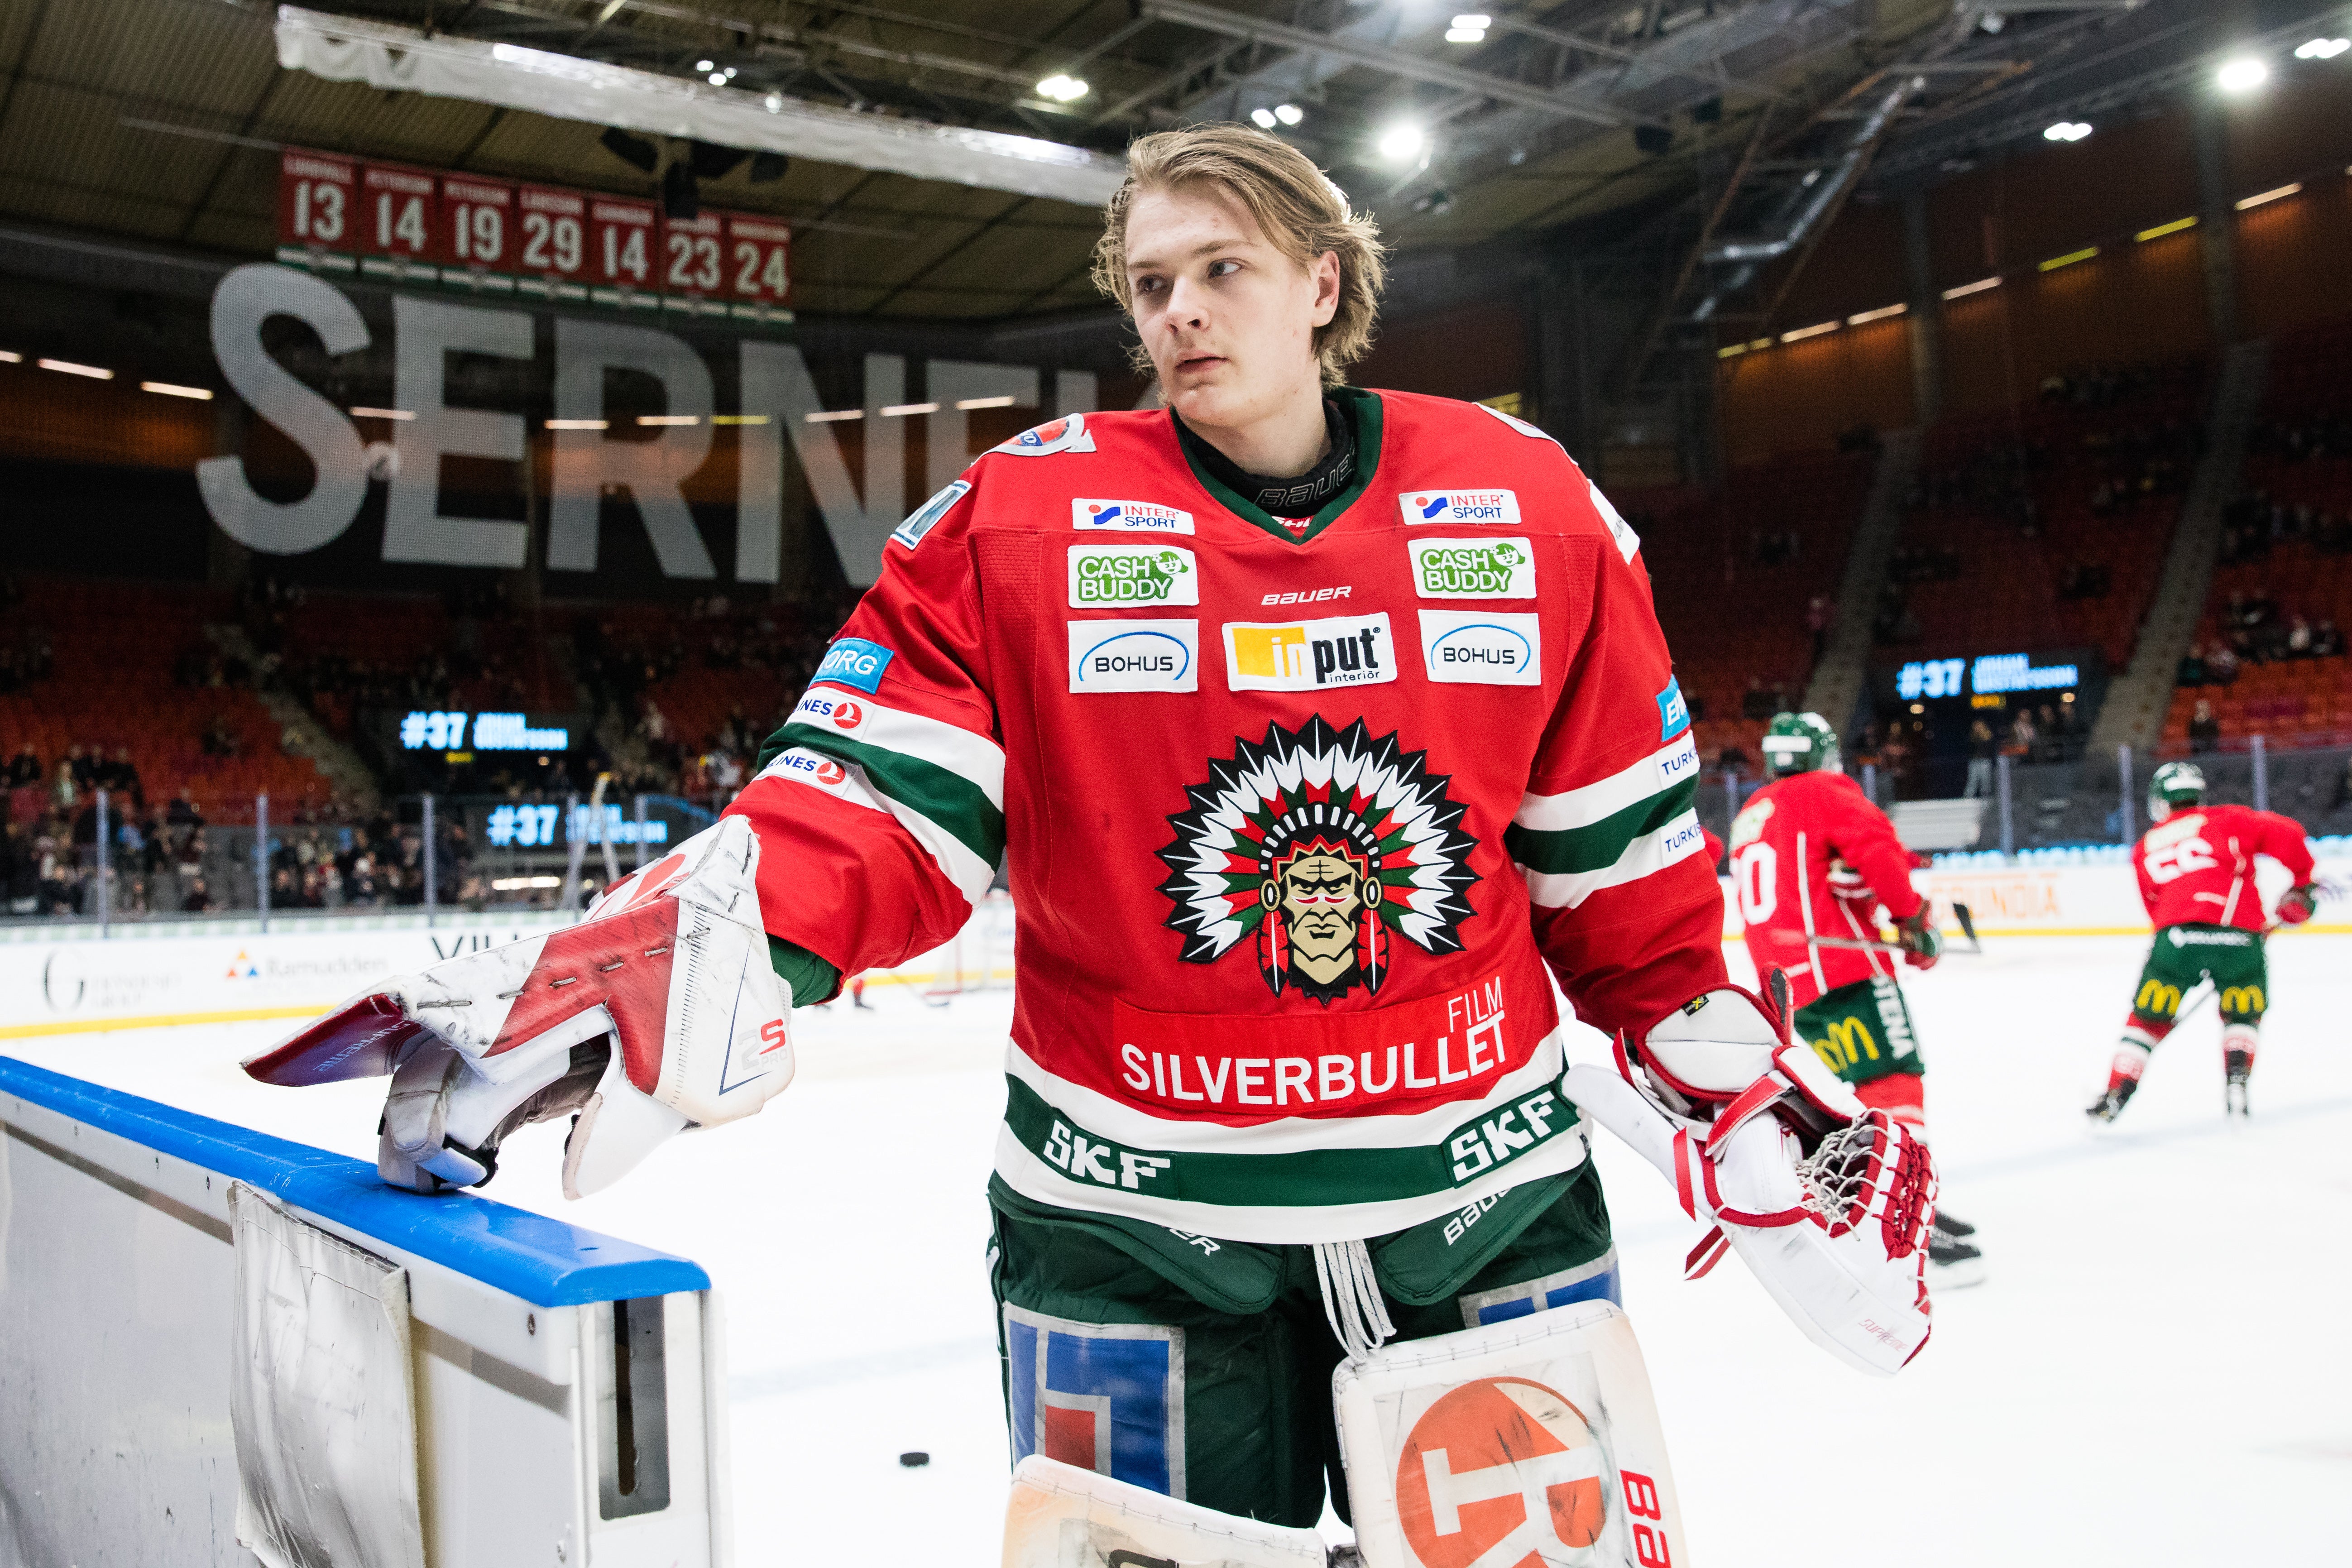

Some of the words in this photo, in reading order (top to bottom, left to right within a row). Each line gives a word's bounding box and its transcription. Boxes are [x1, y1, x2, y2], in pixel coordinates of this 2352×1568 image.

[294, 180, 345, 241] 13
[375, 192, 426, 252] 14
[455, 204, 503, 262] 19
[522, 215, 582, 273] 29
[602, 226, 648, 281] 14
[669, 234, 721, 290] 23
[734, 241, 788, 297] 24
[1126, 505, 1176, 519] INTER
[1451, 495, 1500, 506] INTER
[1454, 507, 1502, 518] SPORT
[1125, 516, 1177, 528] SPORT
[1080, 558, 1150, 578] CASH
[1423, 551, 1489, 570] CASH
[1425, 570, 1511, 590] BUDDY
[1081, 578, 1171, 599] BUDDY
[1095, 656, 1174, 672] BOHUS
[1443, 647, 1515, 664] BOHUS
[1897, 657, 1966, 700] #37
[401, 711, 468, 749] #37
[488, 804, 560, 846] #37
[1449, 976, 1503, 1033] FILM
[761, 1048, 788, 1067] PRO
[1121, 1011, 1505, 1105] SILVERBULLET
[1043, 1118, 1171, 1189] SKF
[1449, 1090, 1555, 1182] SKF
